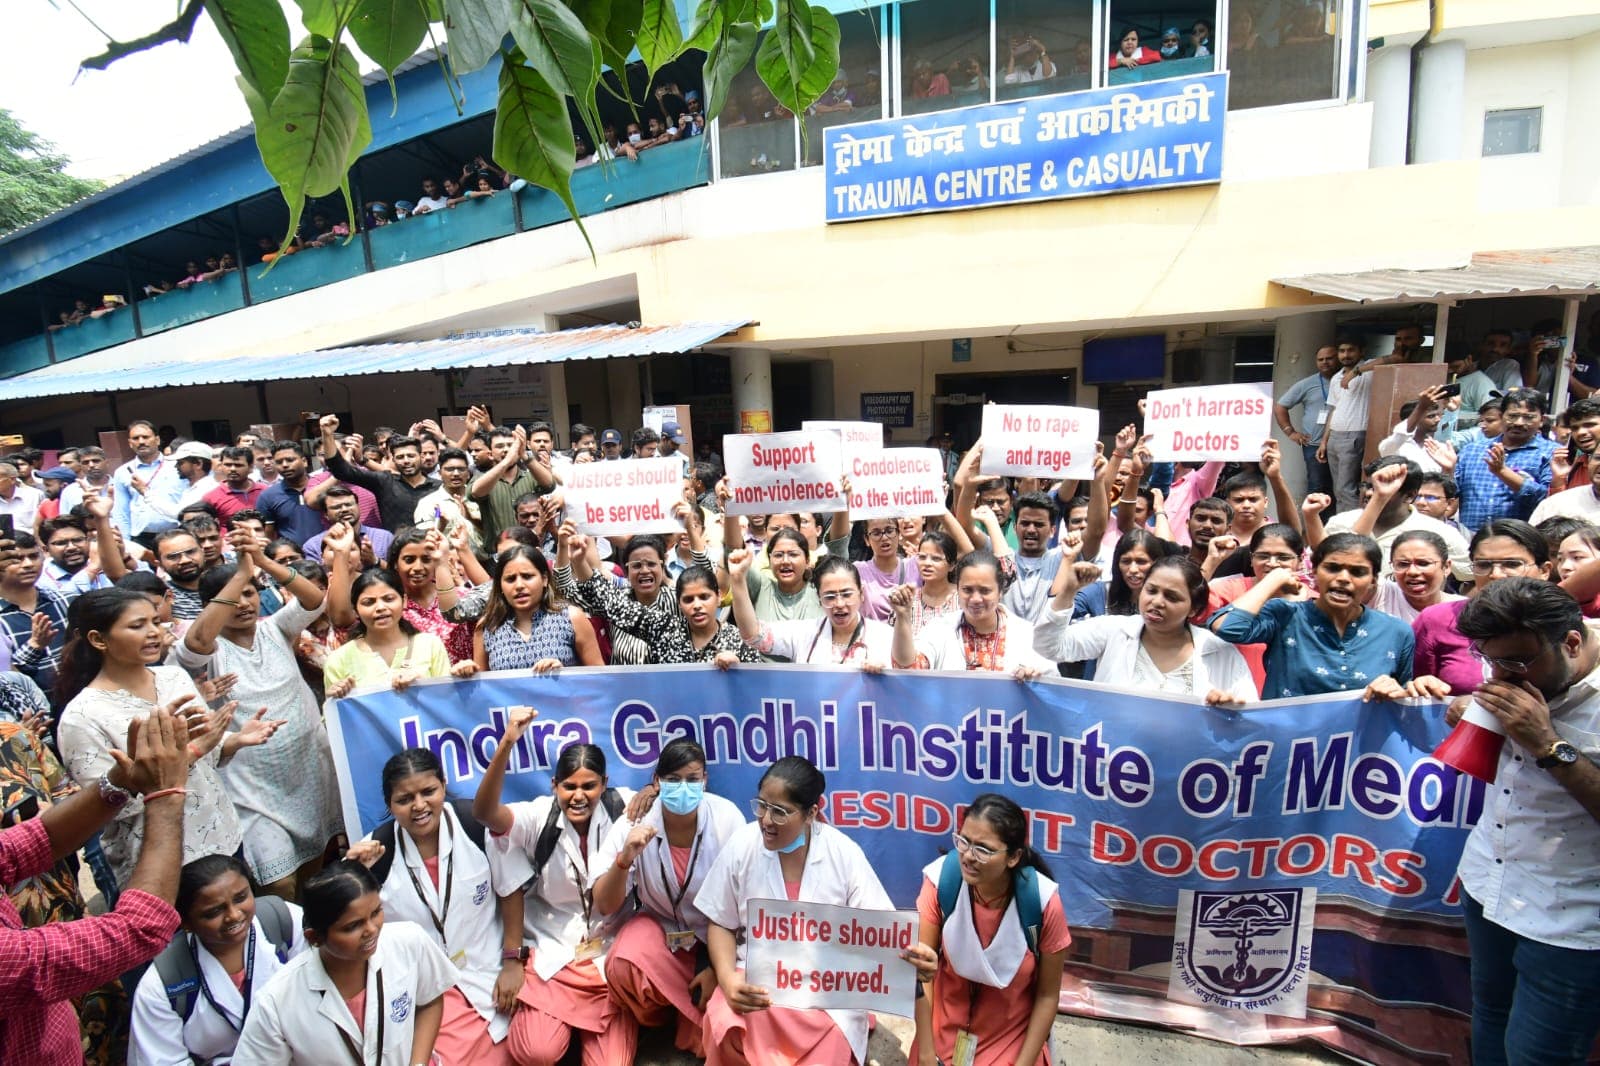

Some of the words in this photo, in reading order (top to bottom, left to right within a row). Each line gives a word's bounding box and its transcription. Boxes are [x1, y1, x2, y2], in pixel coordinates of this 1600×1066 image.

[903, 123, 966, 158] केन्द्र
[975, 107, 1027, 149] एवं
[1036, 83, 1215, 141] आकस्मिकी
[834, 175, 927, 213] TRAUMA
[934, 165, 1031, 203] CENTRE
[1039, 159, 1058, 190] &
[1067, 141, 1212, 188] CASUALTY
[1151, 399, 1194, 420] Don't
[1198, 396, 1265, 416] harrass
[1003, 412, 1024, 432] No
[1027, 411, 1042, 432] to
[1046, 418, 1080, 438] rape
[1172, 430, 1240, 452] Doctors
[752, 440, 816, 471] Support
[852, 454, 932, 477] Condolence
[1006, 446, 1033, 466] and
[1036, 449, 1072, 471] rage
[567, 466, 623, 490] Justice
[626, 462, 678, 487] should
[734, 479, 840, 505] non-violence.
[850, 490, 863, 509] to
[867, 487, 889, 508] the
[893, 484, 938, 506] victim.
[585, 502, 605, 524] be
[608, 496, 667, 523] served.
[611, 698, 839, 772] Gandhi
[857, 700, 1153, 807] Institute
[1177, 740, 1275, 819] of
[1090, 819, 1427, 899] DOCTORS
[752, 908, 832, 942] Justice
[838, 918, 913, 950] should
[776, 960, 802, 990] be
[809, 964, 890, 995] served.
